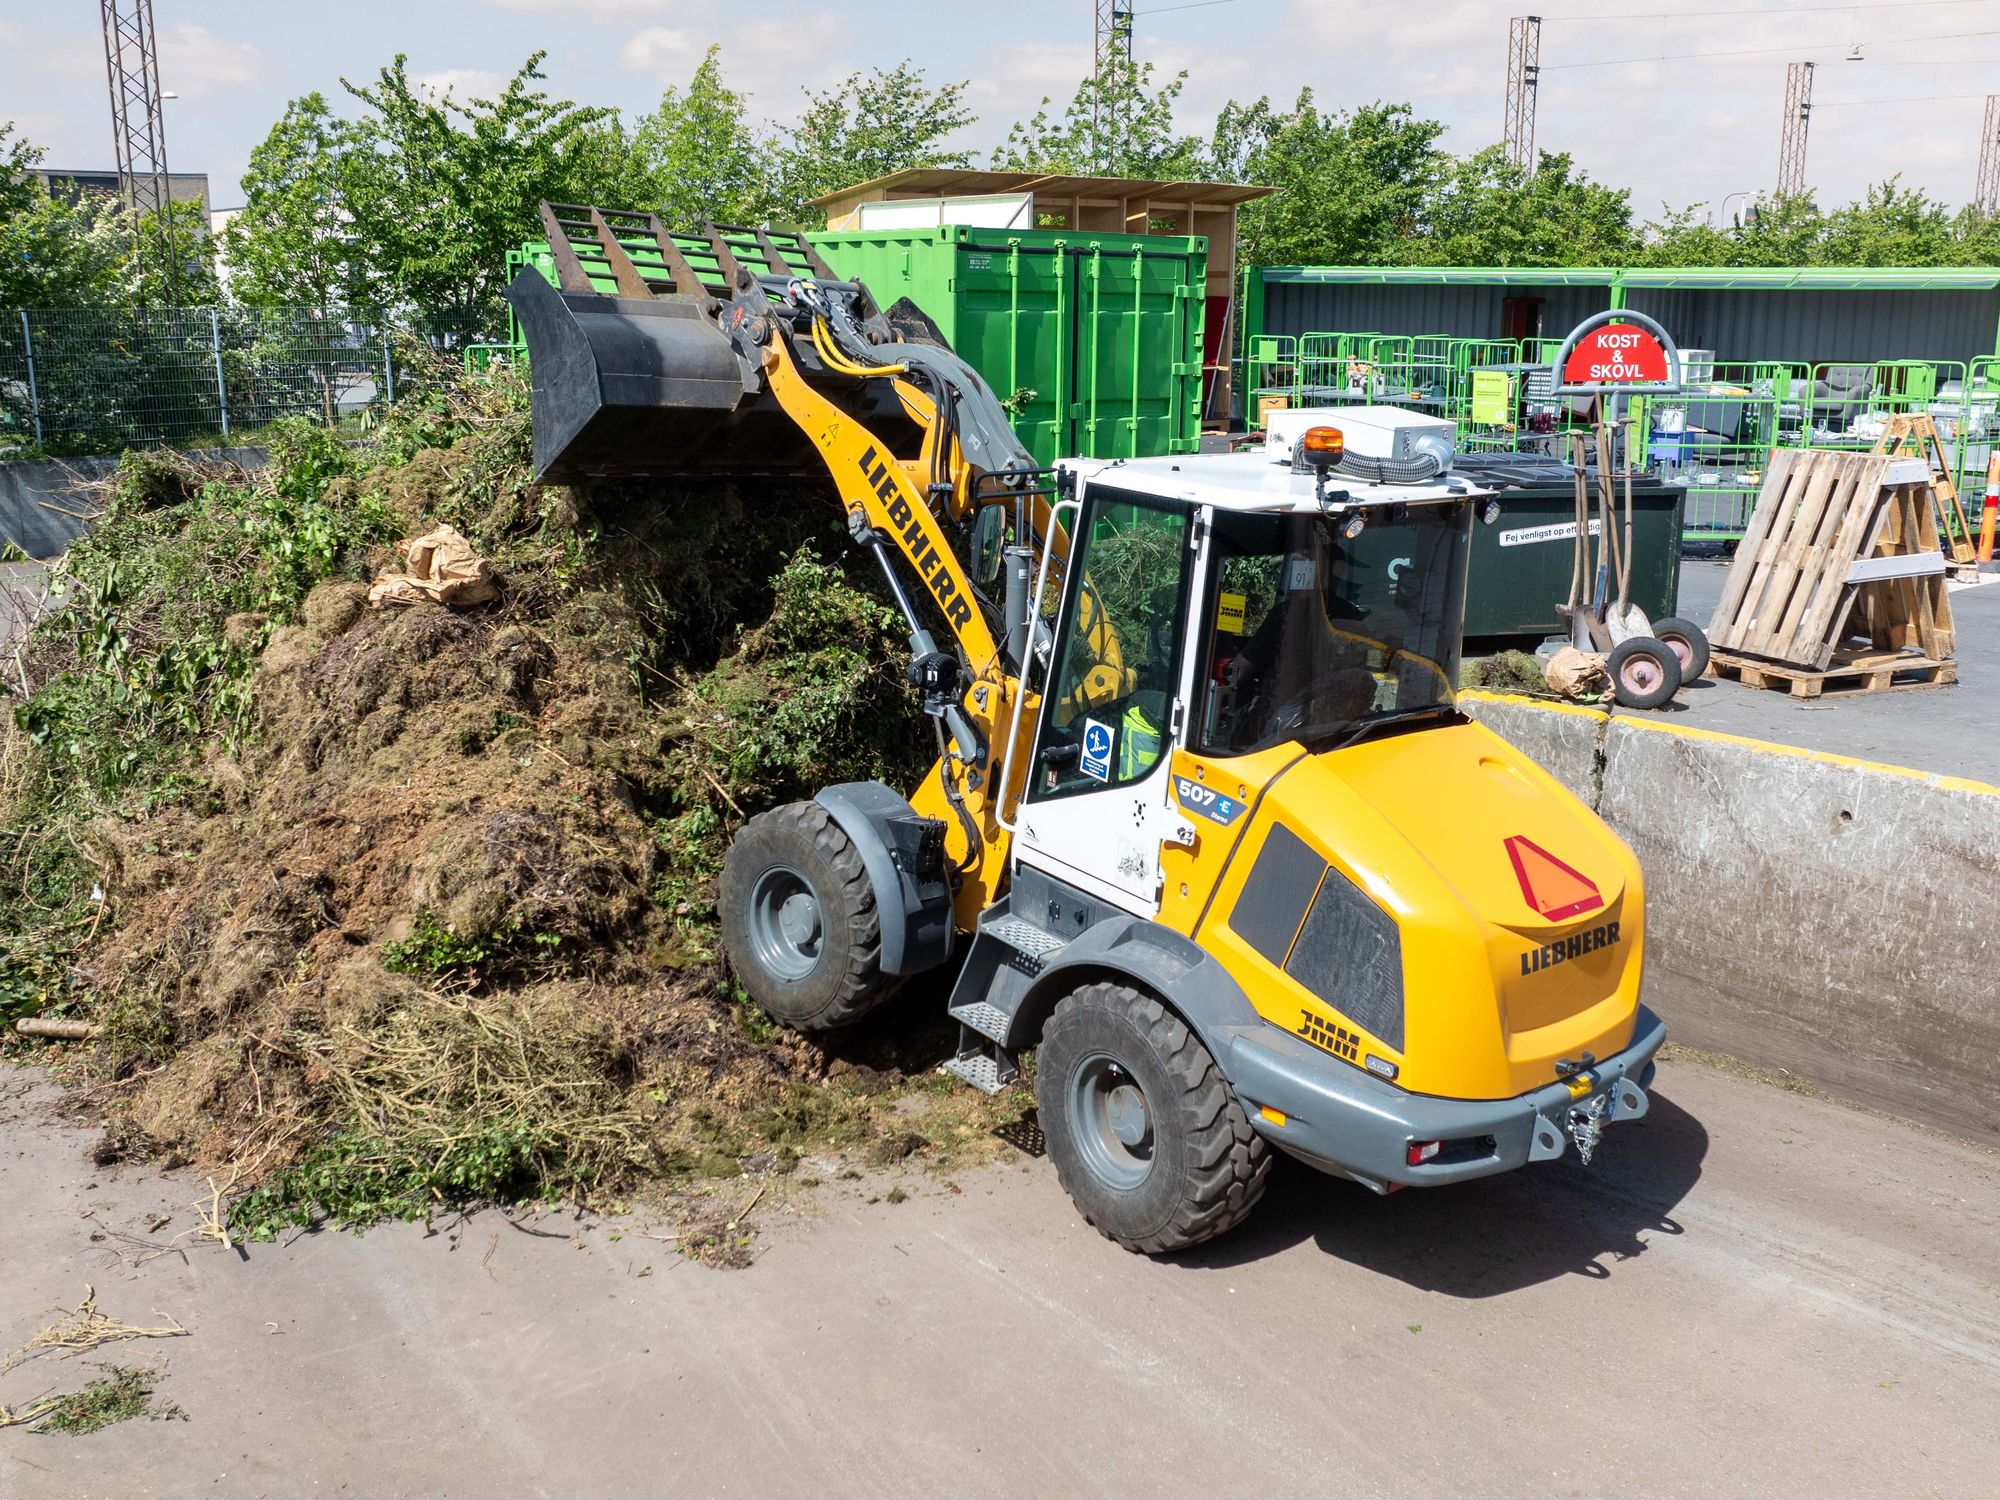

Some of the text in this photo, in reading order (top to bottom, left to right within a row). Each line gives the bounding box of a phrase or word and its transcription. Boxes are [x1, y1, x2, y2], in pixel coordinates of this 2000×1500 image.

[1597, 334, 1641, 348] KOST
[1612, 350, 1623, 362] &
[1590, 364, 1644, 378] SKOVL
[858, 445, 973, 633] LIEBHERR
[1505, 533, 1518, 542] Fej
[1520, 530, 1552, 540] venligst
[1553, 528, 1564, 538] op
[1178, 779, 1216, 806] 507
[1210, 811, 1228, 824] Stereo
[1521, 921, 1621, 976] LIEBHERR
